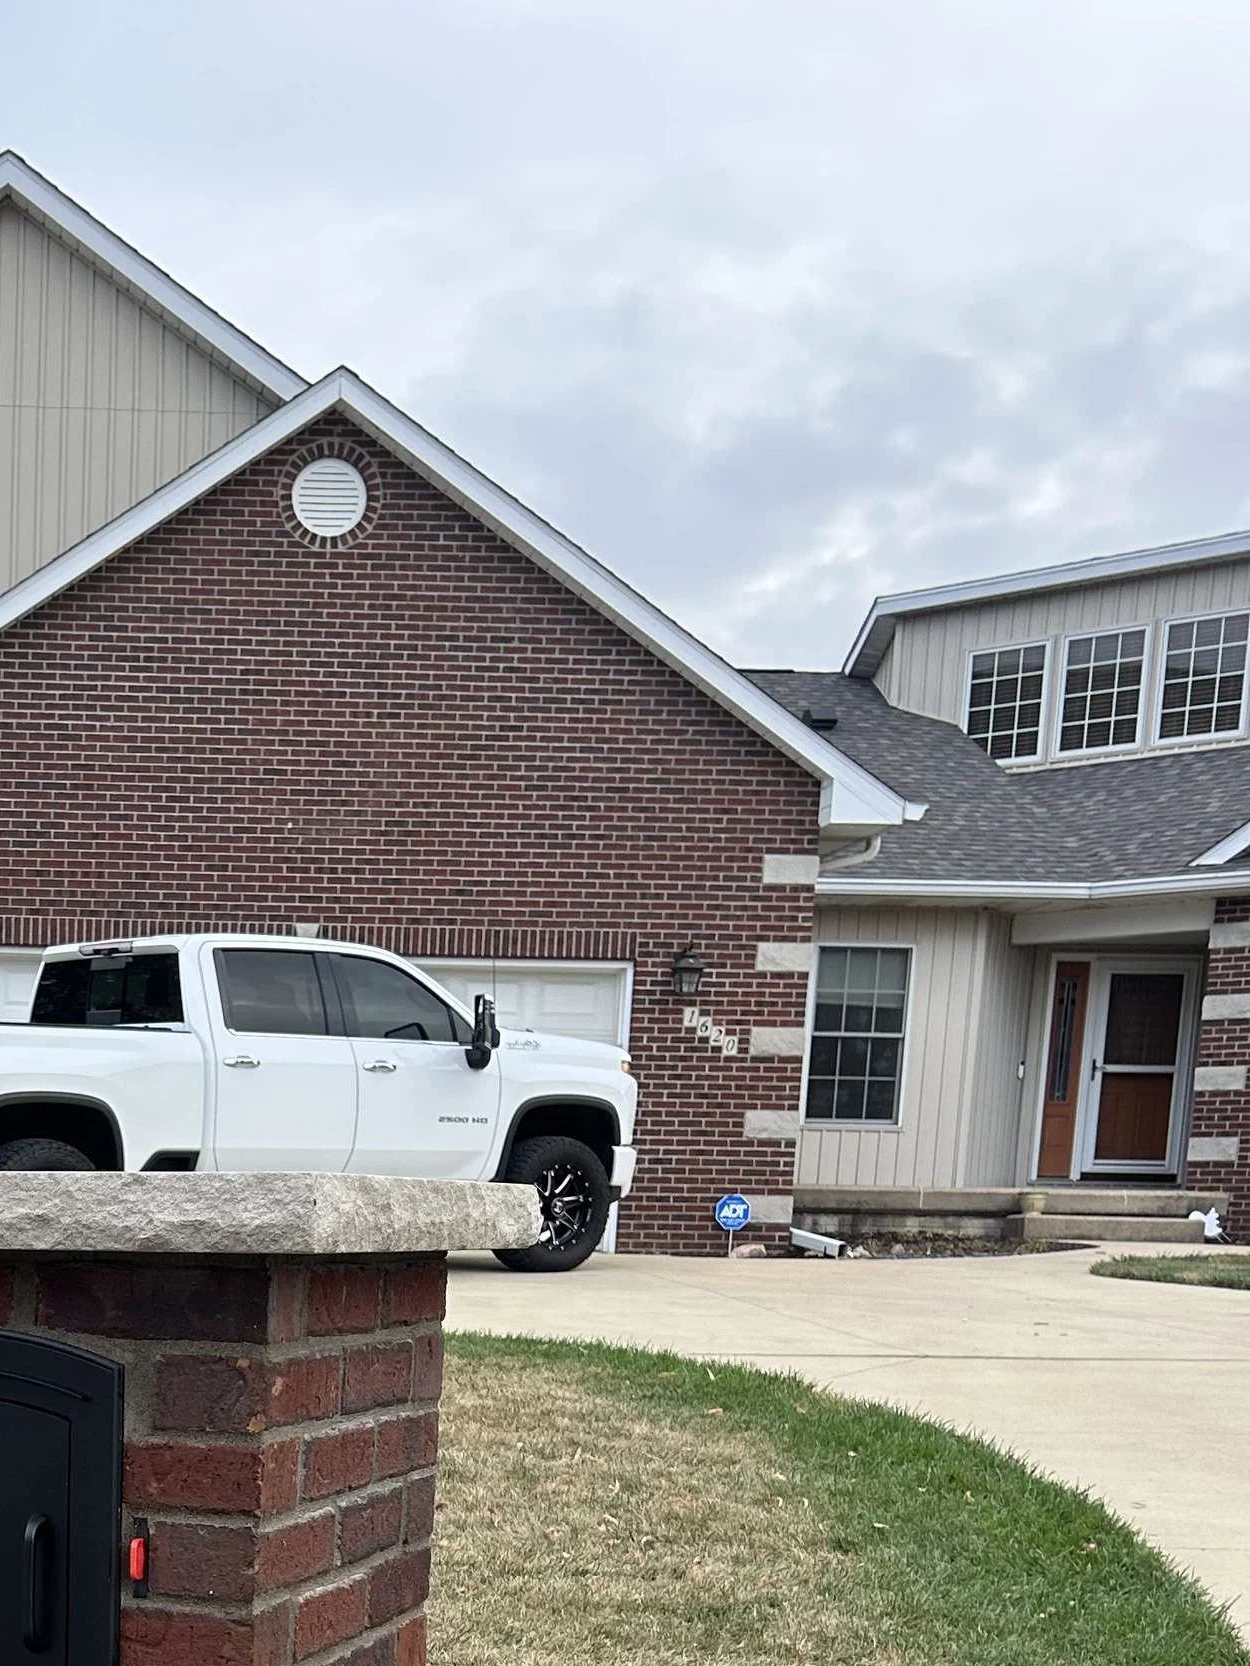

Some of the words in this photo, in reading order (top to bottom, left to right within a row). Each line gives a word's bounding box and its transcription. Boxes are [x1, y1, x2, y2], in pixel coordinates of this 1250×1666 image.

[688, 1009, 736, 1052] 1620
[438, 1116, 469, 1124] 2500
[719, 1204, 748, 1219] ADT
